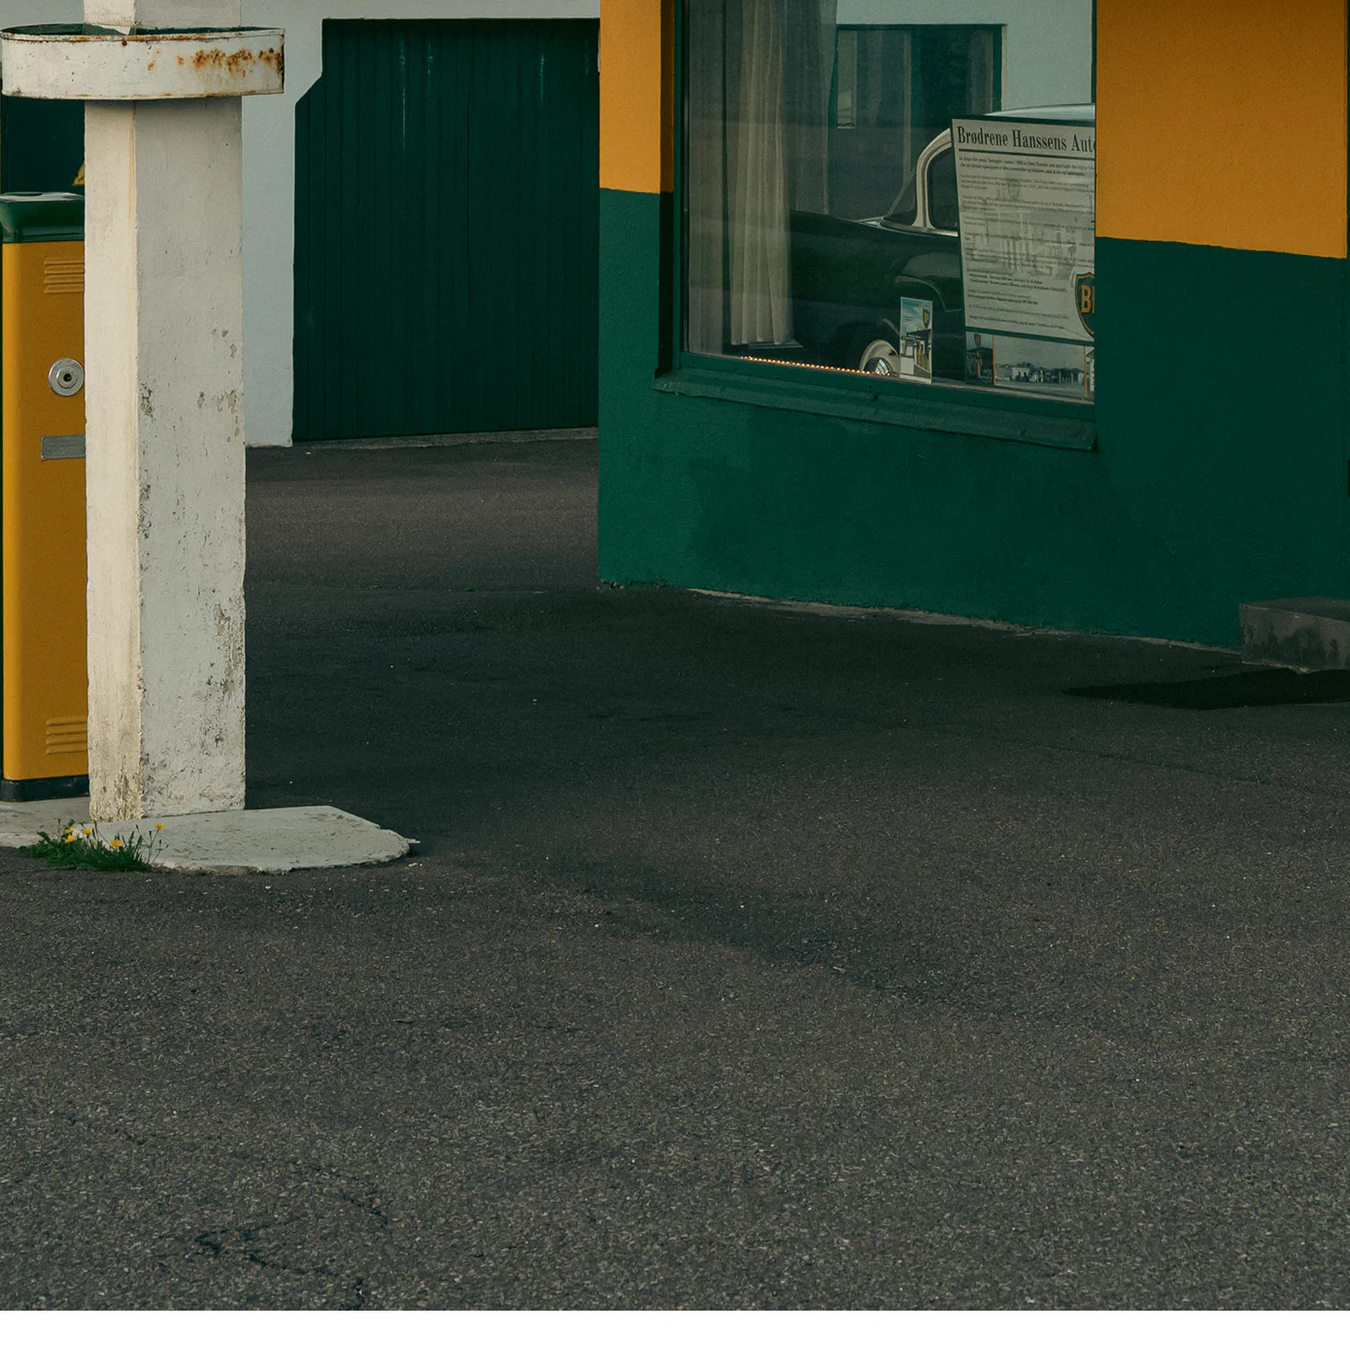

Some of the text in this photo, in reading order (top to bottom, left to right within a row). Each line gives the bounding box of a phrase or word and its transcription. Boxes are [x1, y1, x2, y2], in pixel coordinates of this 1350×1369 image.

[957, 125, 1008, 147] Brødrene
[1012, 129, 1067, 151] Hanssens
[1081, 285, 1095, 314] B
